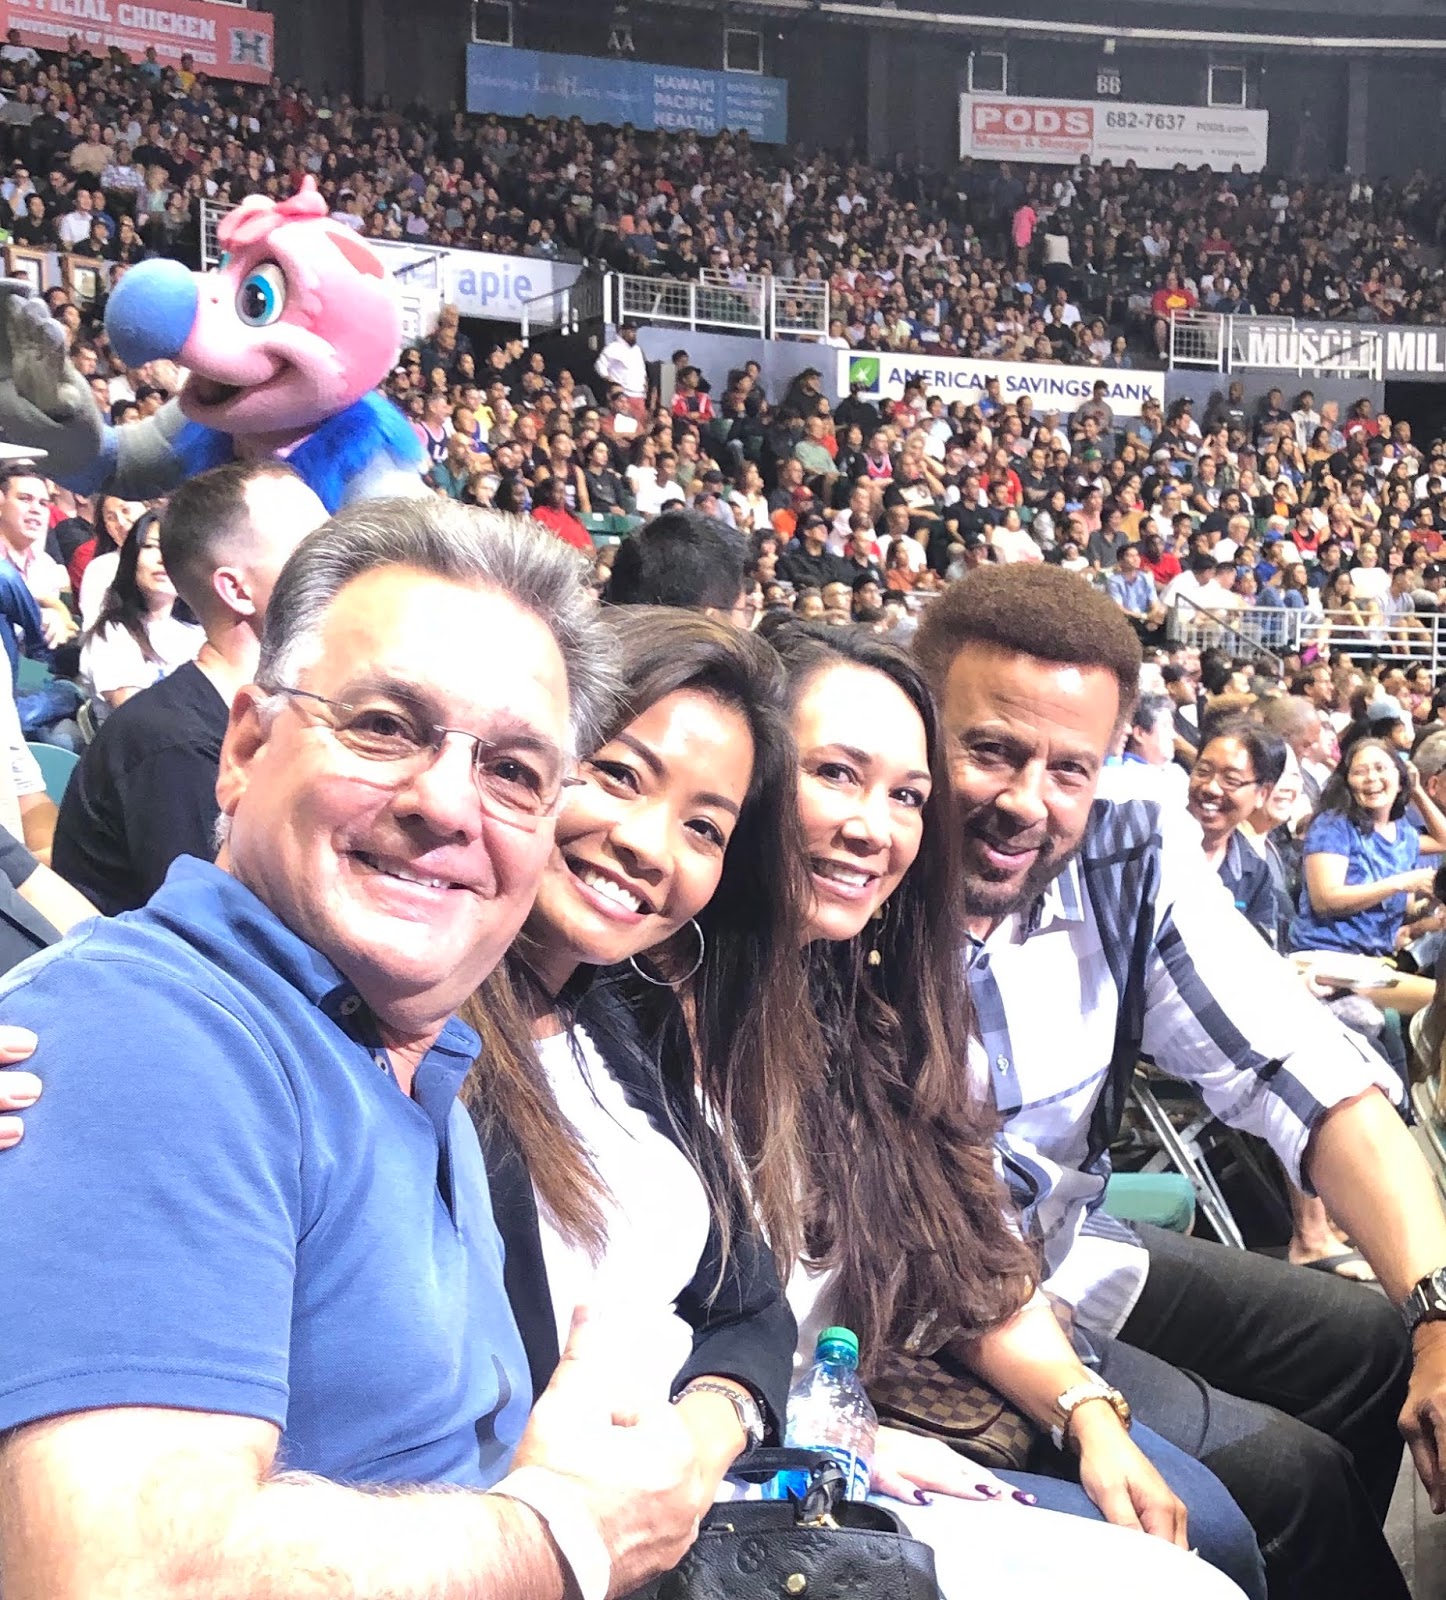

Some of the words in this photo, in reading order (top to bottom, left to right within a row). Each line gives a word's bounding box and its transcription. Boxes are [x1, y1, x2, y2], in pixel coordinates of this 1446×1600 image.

[118, 3, 217, 41] CHICKEN
[653, 111, 715, 130] HEALTH
[975, 107, 1090, 134] PODS
[1106, 111, 1185, 131] 682-7637
[1006, 375, 1091, 397] SAVINGS
